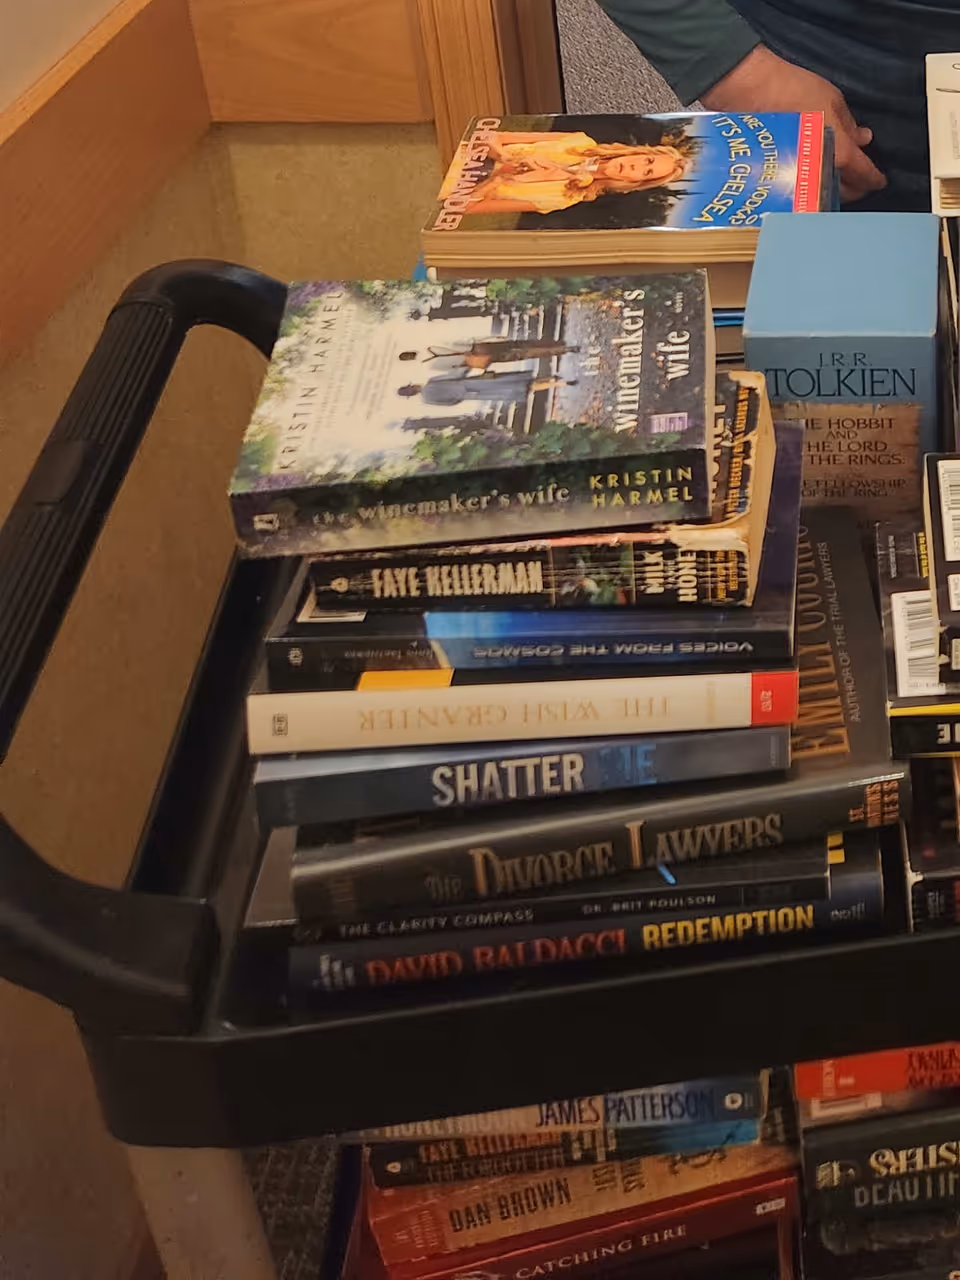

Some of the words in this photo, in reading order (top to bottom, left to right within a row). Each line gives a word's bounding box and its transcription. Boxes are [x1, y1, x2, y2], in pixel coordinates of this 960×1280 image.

[712, 116, 742, 137] IT'S
[738, 113, 764, 130] ARE
[756, 128, 776, 149] YOU
[461, 117, 501, 170] CHELSEA
[727, 137, 751, 162] ME,
[431, 167, 482, 232] HANDLER
[692, 163, 751, 222] CHELSEA
[610, 289, 646, 434] winemaker's
[656, 330, 691, 381] wife
[280, 386, 317, 471] KRISTIN
[311, 291, 343, 375] HARMEL
[765, 368, 916, 398] TOLKIEN
[826, 431, 858, 440] AND
[828, 418, 894, 430] HOBBIT
[808, 454, 844, 466] THE
[838, 441, 888, 453] LORD
[589, 466, 693, 489] KRISTIN
[358, 488, 509, 523] winemaker's
[517, 484, 570, 508] wife
[593, 486, 693, 508] HARMEL
[372, 568, 421, 598] FAYE
[427, 561, 544, 598] KELLERMAN
[644, 551, 665, 595] MILK
[677, 551, 697, 603] HONE
[817, 541, 832, 589] LAWYERS
[826, 589, 843, 621] TRIAL
[573, 642, 611, 657] THE
[621, 641, 675, 656] FROM
[681, 641, 754, 657] VOICES
[832, 622, 848, 647] THE
[473, 644, 563, 660] COSMOS
[838, 648, 850, 665] OF
[621, 696, 671, 719] THE
[842, 663, 861, 722] AUTHOR
[356, 703, 508, 733] GRANTER
[523, 701, 598, 722] WISH
[432, 753, 585, 808] SHATTER
[453, 907, 534, 930] COMPASS
[366, 953, 463, 986] DAVID
[472, 929, 626, 973] BALDACCI
[642, 904, 814, 951] REDEMPTION
[535, 1095, 601, 1128] JAMES
[605, 1088, 714, 1123] PATTERSON
[449, 1207, 491, 1233] DAN
[499, 1177, 572, 1220] BROWN
[516, 1239, 633, 1279] CATCHING
[641, 1224, 687, 1249] FIRE
